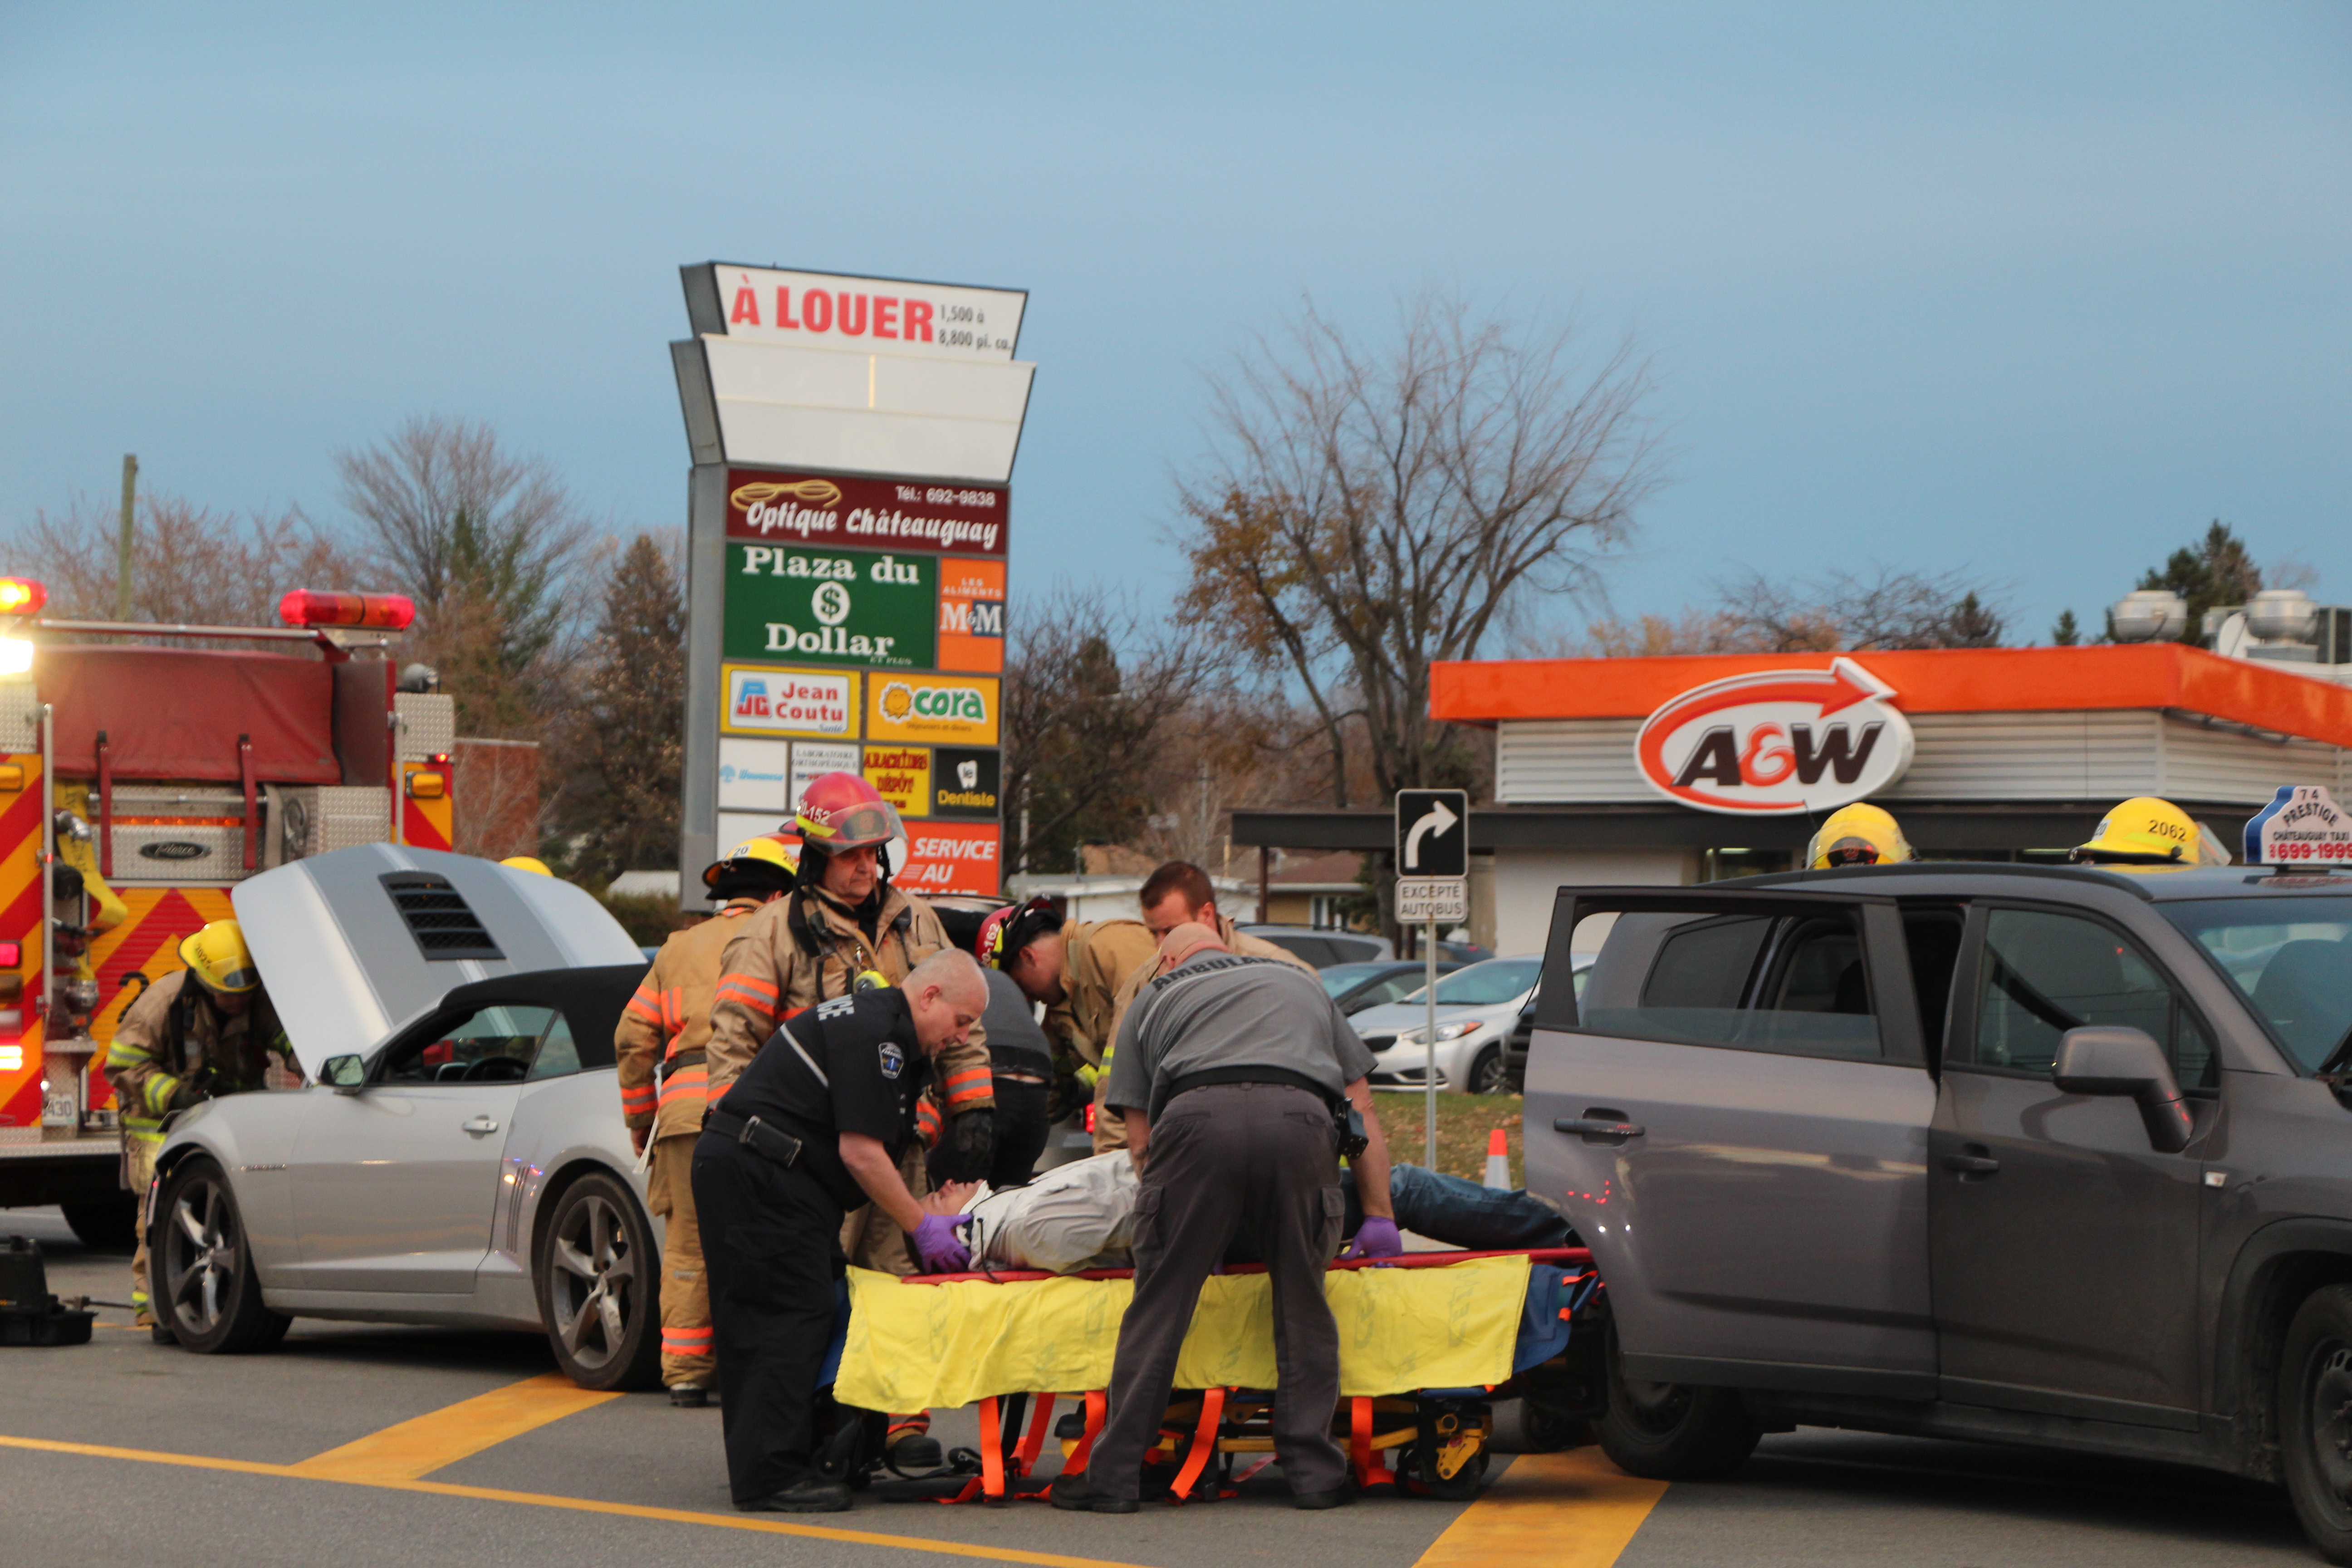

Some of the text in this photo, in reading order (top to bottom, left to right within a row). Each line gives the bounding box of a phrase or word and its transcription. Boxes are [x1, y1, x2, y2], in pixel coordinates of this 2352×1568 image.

[731, 274, 933, 343] À LOUER
[940, 304, 985, 323] 1,500 à
[939, 329, 973, 348] 8,800
[977, 333, 991, 351] pi.
[926, 488, 996, 507] 692-9838
[746, 500, 998, 550] Optique Châteauguay
[741, 546, 919, 585] Plaza du
[943, 585, 1002, 598] ALIMENTS
[961, 577, 984, 587] LES
[939, 602, 1002, 632] M&M
[765, 622, 895, 657] Dollar
[782, 681, 838, 701] Jean
[776, 702, 843, 721] Coutu
[914, 690, 984, 720] cora
[1670, 721, 1886, 787] A&W
[877, 772, 914, 793] DÉPÔT
[937, 789, 997, 807] Dentiste
[2283, 802, 2338, 827] PRESTIGE
[2148, 818, 2187, 842] 2062
[2330, 831, 2350, 841] TAXI
[732, 845, 749, 857] 20
[912, 837, 997, 861] SERVICE
[919, 863, 954, 883] AU
[1401, 902, 1461, 915] AUTOBUS
